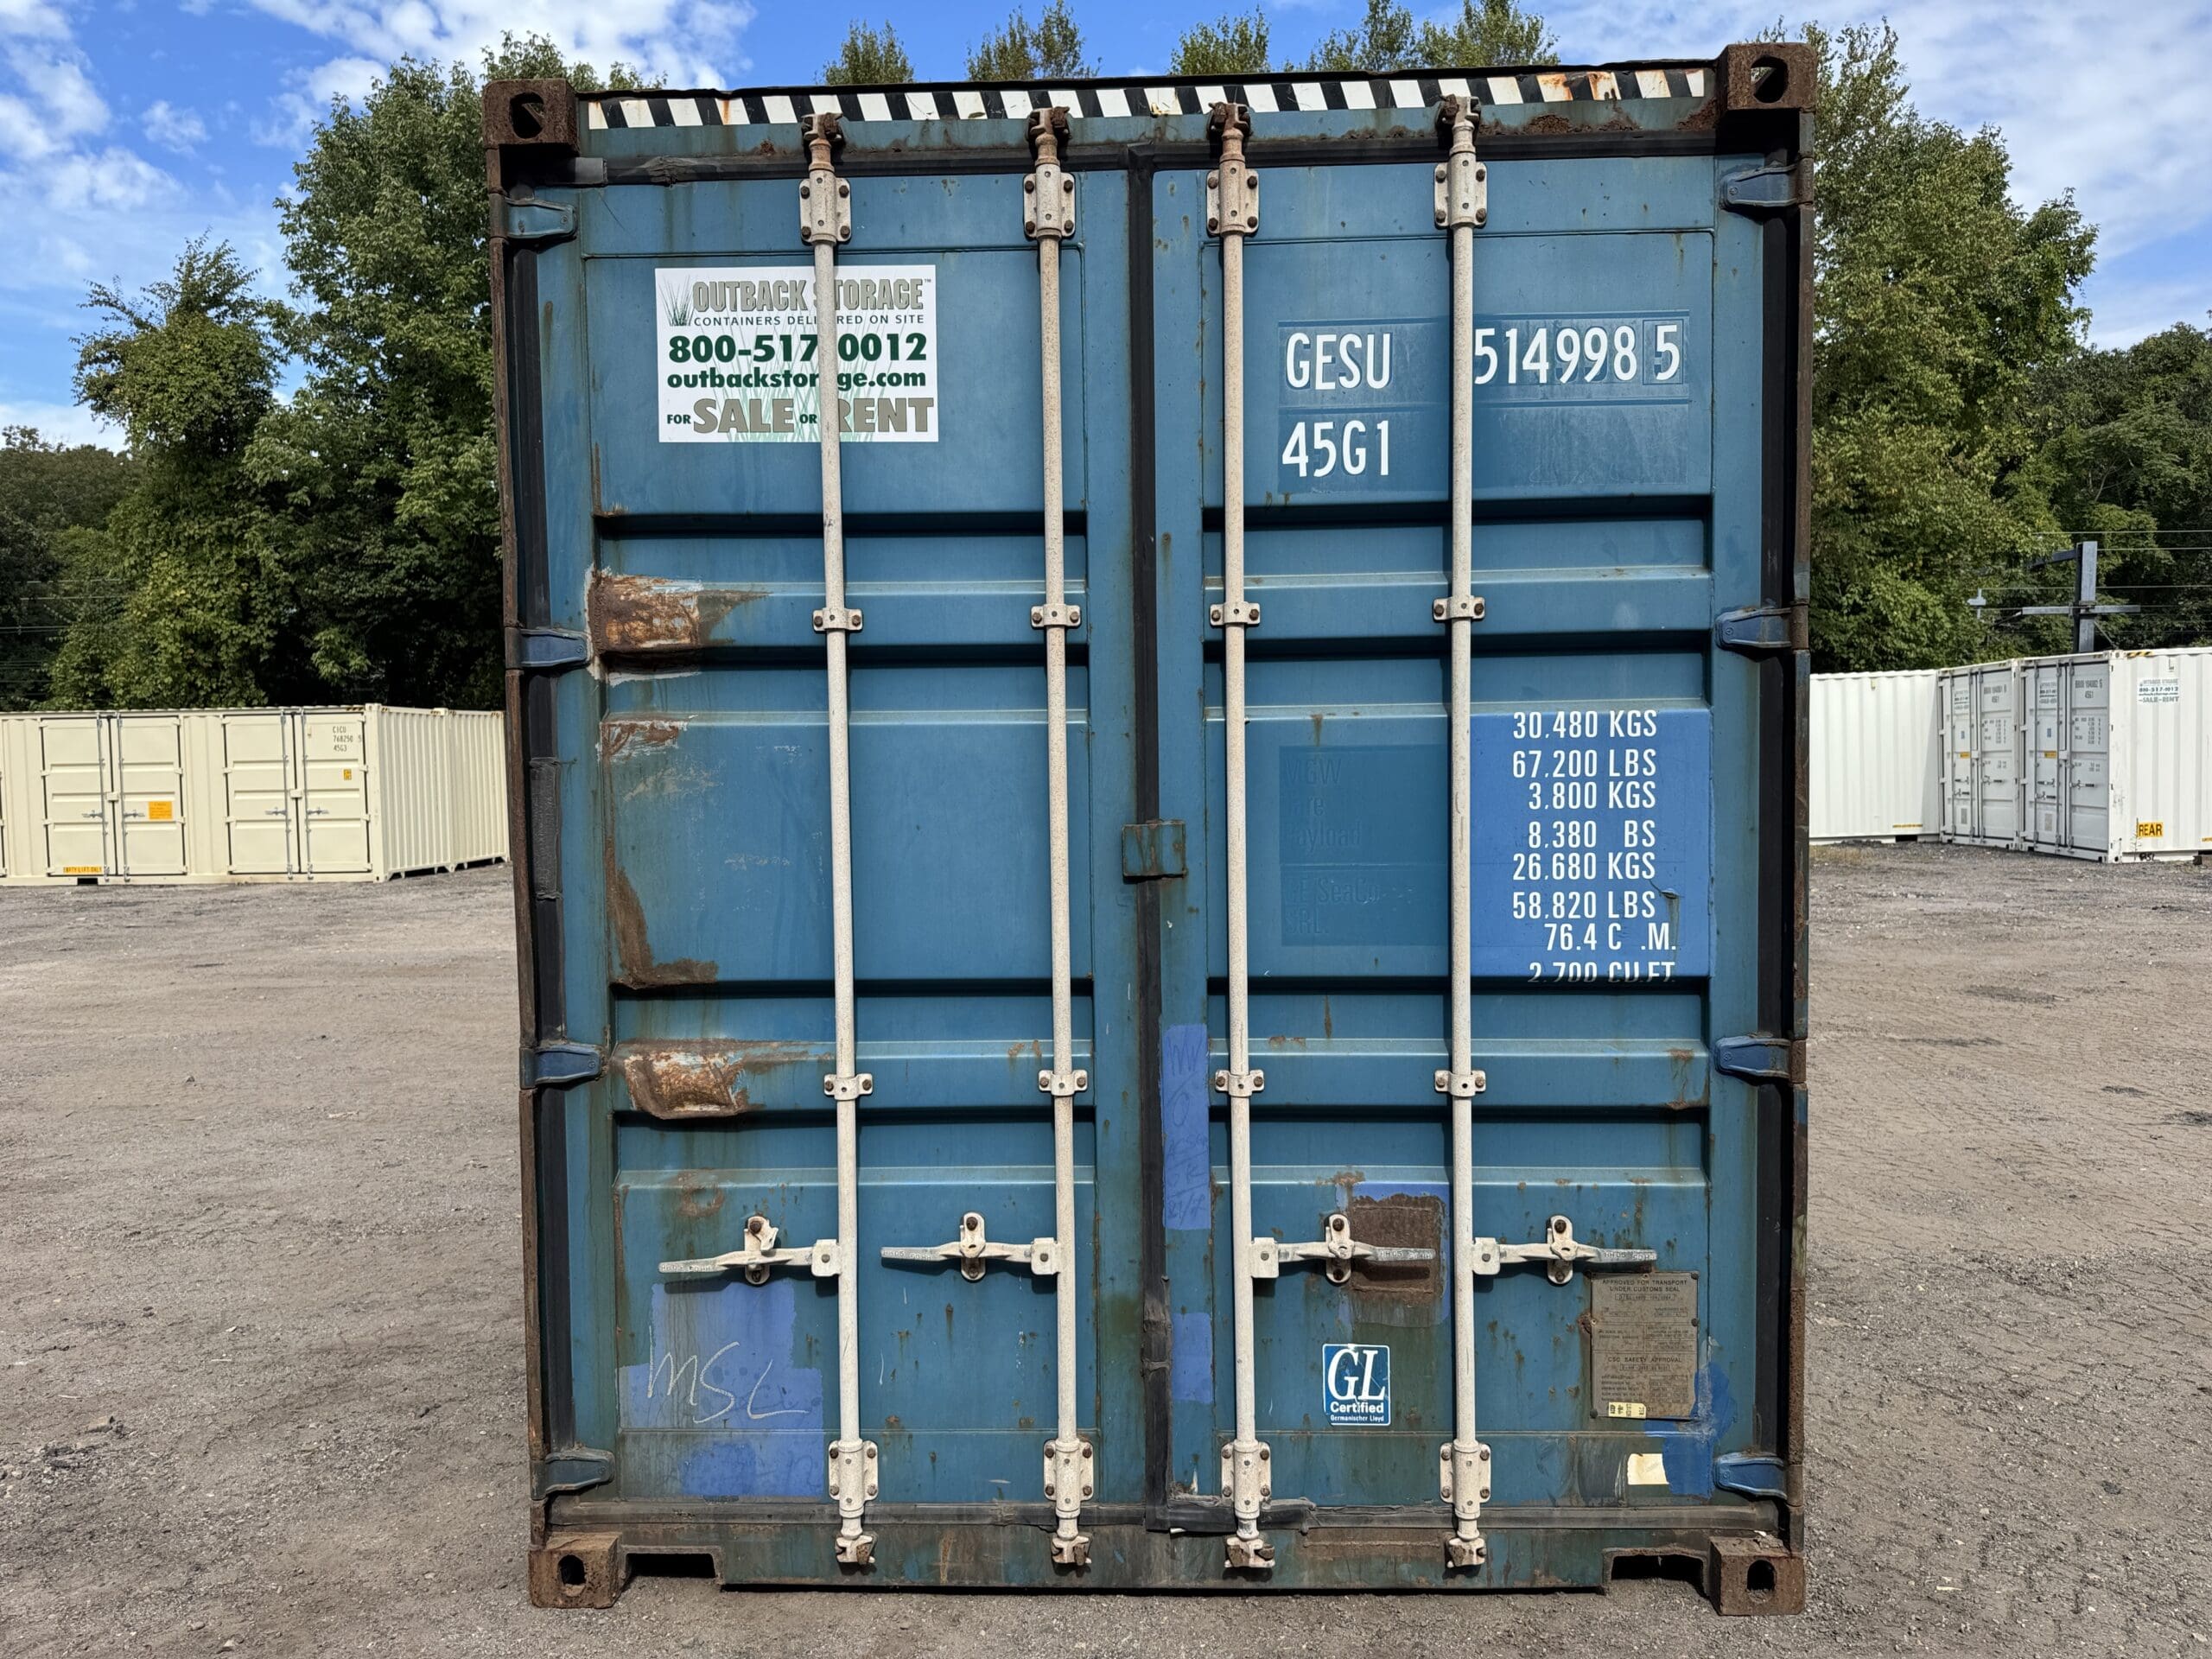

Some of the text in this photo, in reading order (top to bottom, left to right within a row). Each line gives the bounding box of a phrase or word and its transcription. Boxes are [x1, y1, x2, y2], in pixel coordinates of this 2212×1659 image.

[692, 279, 808, 312] OUTBACK
[694, 314, 925, 327] CONTAINERS DELIRED ON SITE
[669, 332, 927, 363] 800-5170012
[1286, 324, 1681, 391] GESU 514998 5
[667, 366, 926, 391] outbackstorge.com
[666, 414, 691, 425] FOR
[693, 397, 795, 433] SALE
[799, 413, 817, 424] OR
[1282, 419, 1389, 478] 45G1
[1512, 709, 1657, 739] 30,480 KGS
[1512, 748, 1656, 779] 67,200 LBS
[1529, 781, 1656, 810] 3,800 KGS
[1529, 821, 1598, 849] 8,380
[2139, 823, 2164, 837] REAR
[1512, 851, 1656, 880] 26,680 KGS
[1512, 891, 1656, 920] 58,820 LBS
[1544, 923, 1598, 951] 76.4
[1327, 1348, 1386, 1400] GL
[1330, 1401, 1384, 1413] Certified
